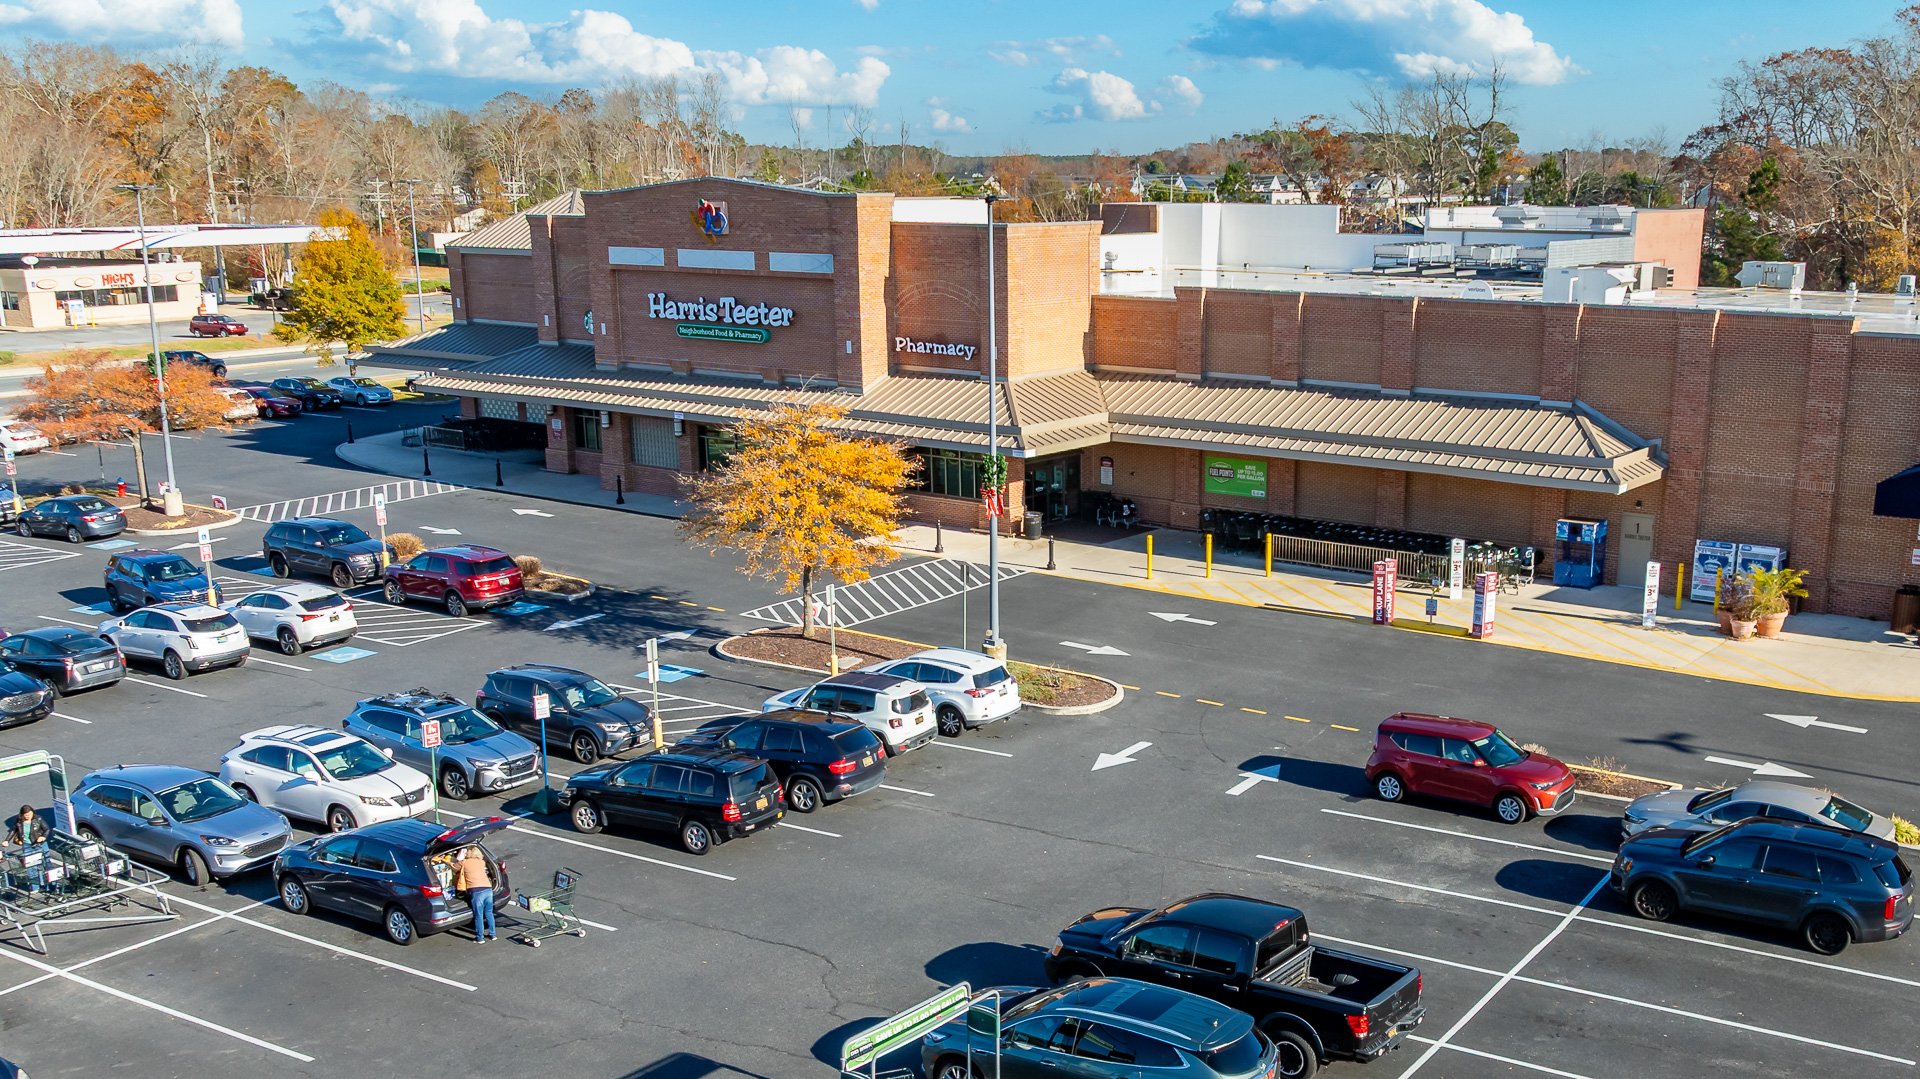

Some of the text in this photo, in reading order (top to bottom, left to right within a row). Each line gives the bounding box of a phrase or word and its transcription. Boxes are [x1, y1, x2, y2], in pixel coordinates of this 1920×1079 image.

[101, 273, 135, 286] HIGH'S
[647, 292, 793, 327] Harris Teeter
[679, 326, 714, 336] Neighborhood
[715, 328, 728, 337] Food
[734, 330, 762, 340] Pharmacy
[894, 336, 976, 361] Pharmacy
[1376, 576, 1384, 595] LANE
[1376, 595, 1384, 621] PICKUP
[875, 1028, 893, 1042] SAVE
[941, 992, 965, 1009] GALLON
